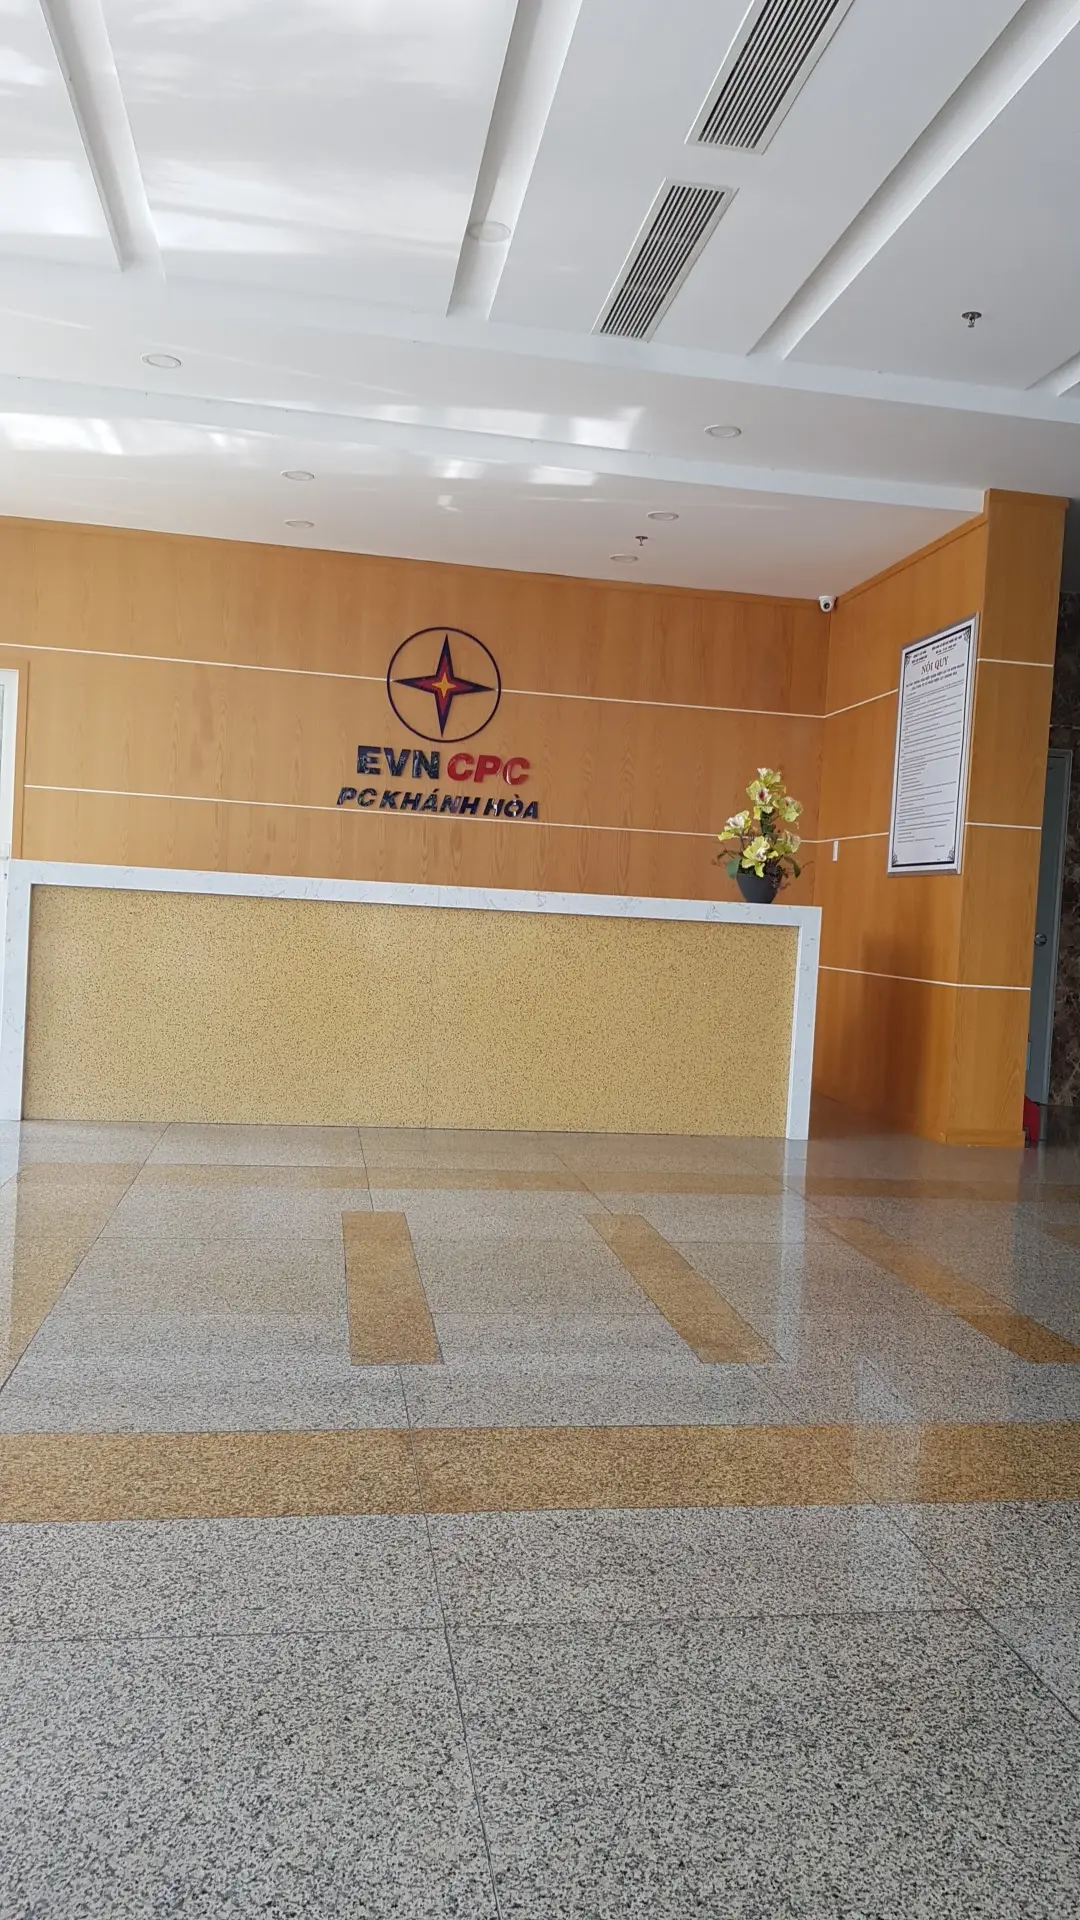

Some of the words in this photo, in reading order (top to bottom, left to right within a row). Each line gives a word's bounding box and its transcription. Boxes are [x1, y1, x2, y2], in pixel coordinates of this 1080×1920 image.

[935, 656, 949, 670] QUY
[357, 745, 440, 779] EVN
[447, 752, 531, 786] CPC
[336, 787, 378, 807] PC
[379, 788, 481, 815] KHÁNH
[483, 794, 539, 819] HÒA
